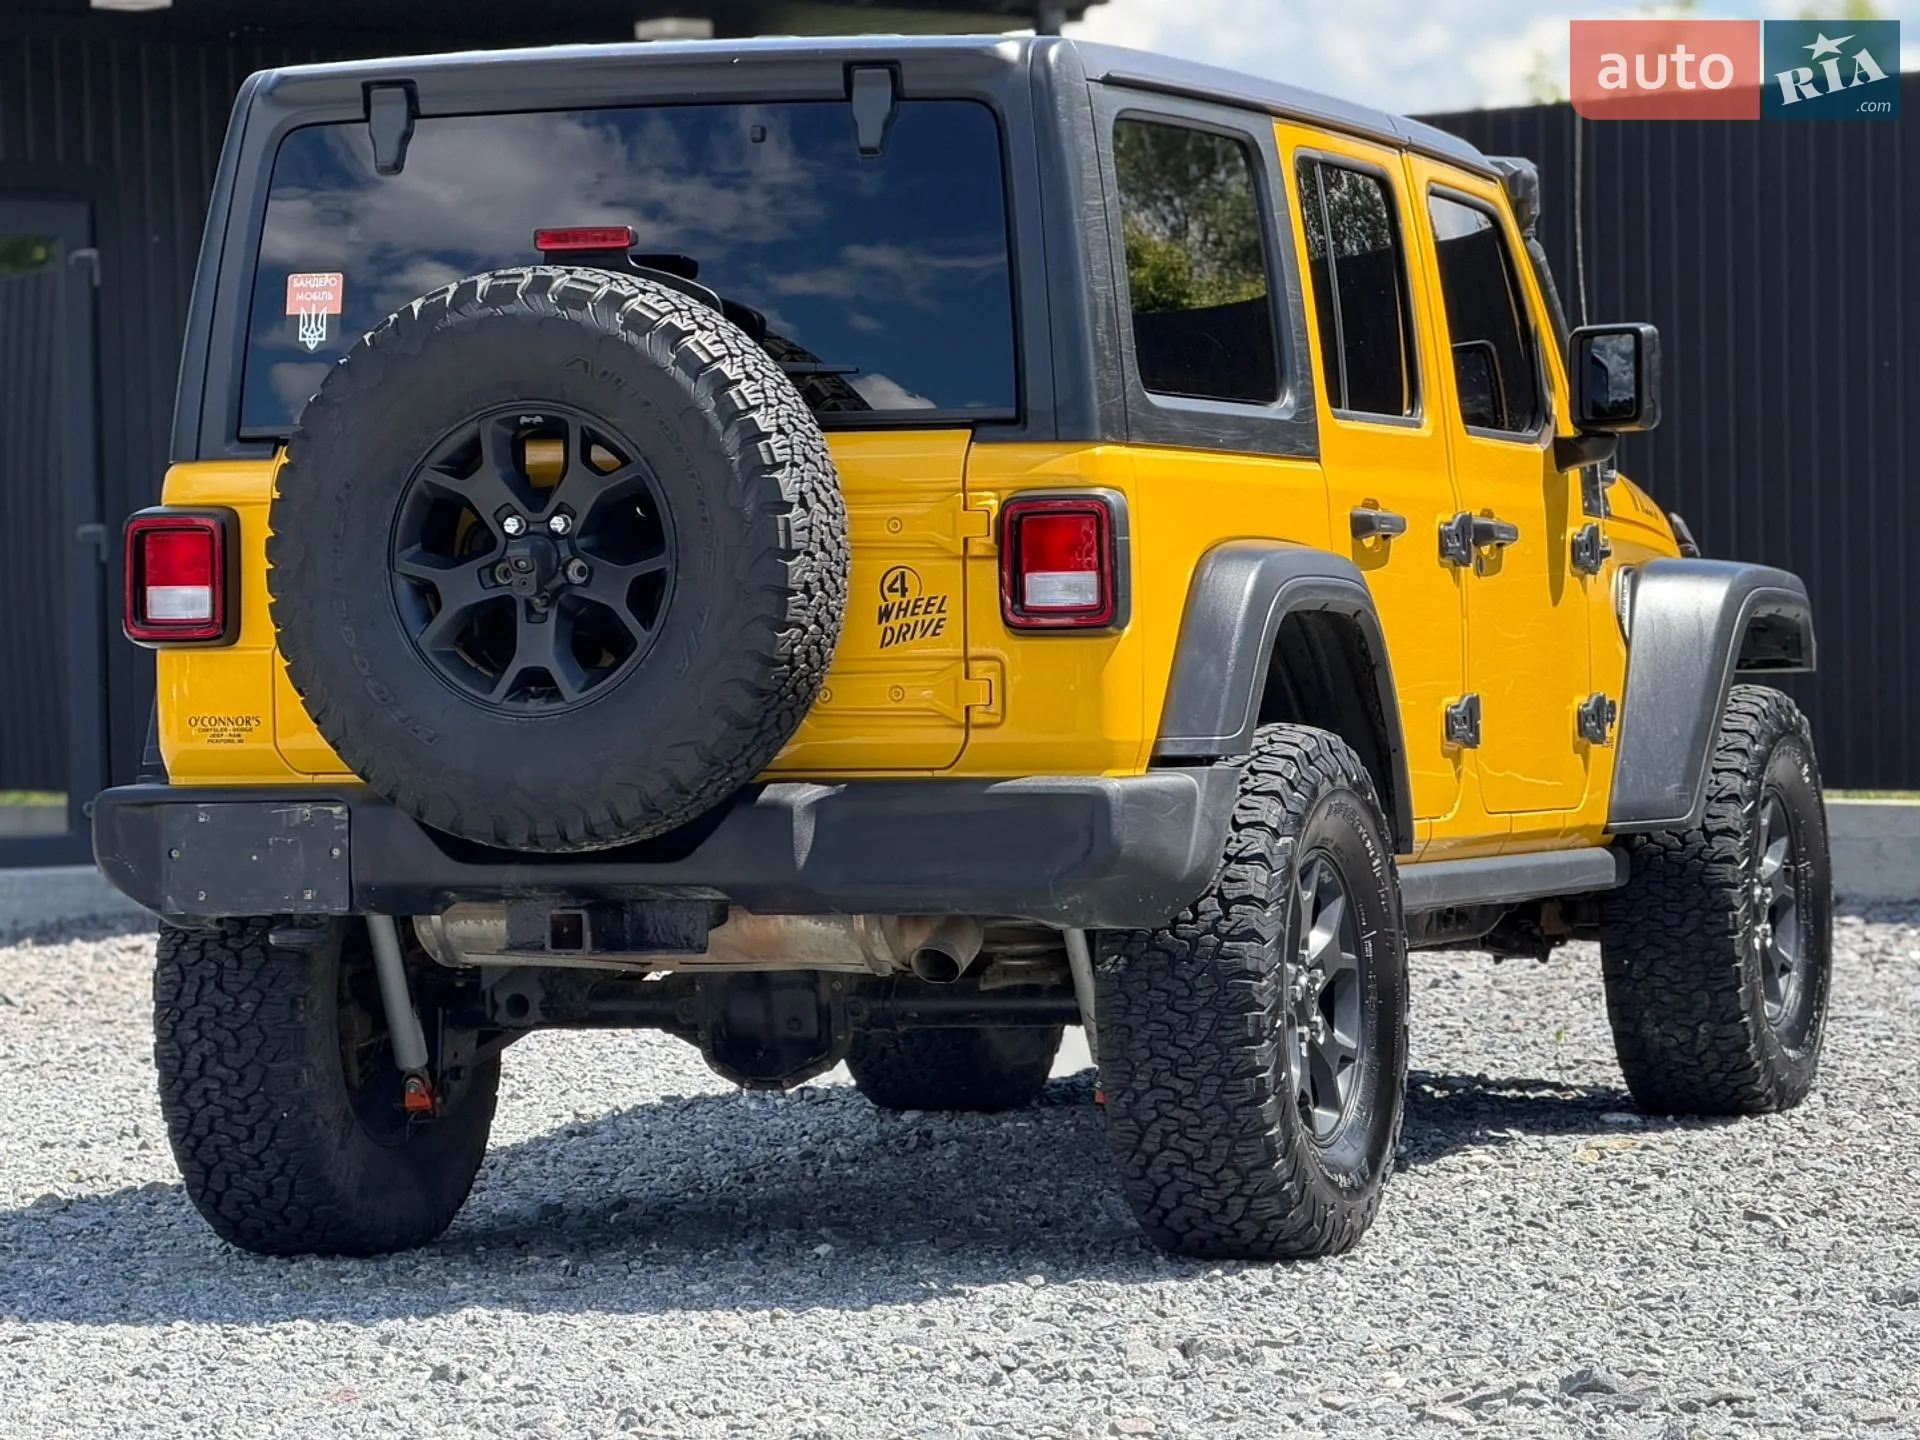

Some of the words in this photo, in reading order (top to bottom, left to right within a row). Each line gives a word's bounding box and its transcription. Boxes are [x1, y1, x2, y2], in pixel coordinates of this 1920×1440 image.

[886, 570, 909, 599] 4
[877, 594, 948, 627] WHEEL
[879, 616, 948, 650] DRIVE
[187, 715, 262, 728] O'CONNOR'S
